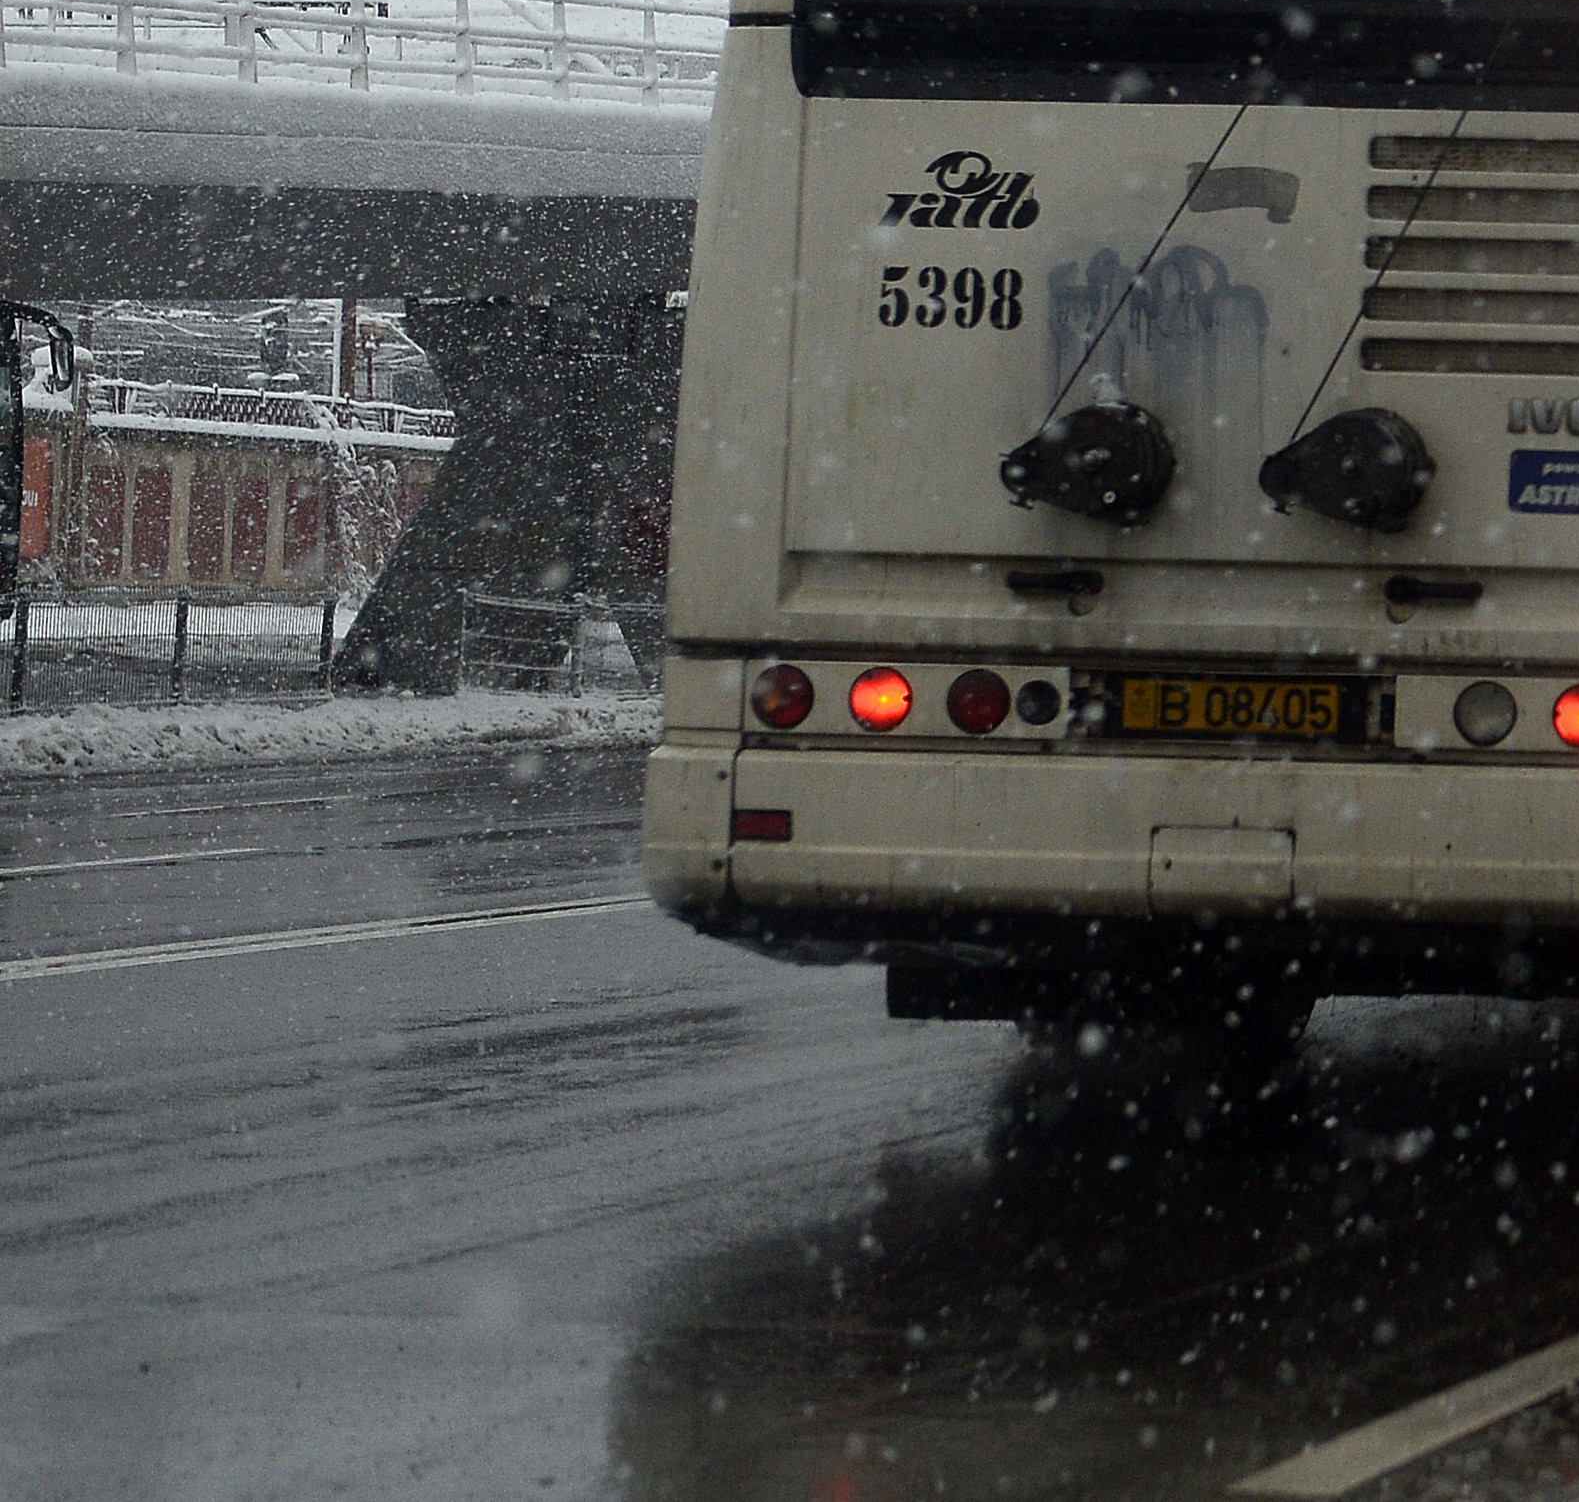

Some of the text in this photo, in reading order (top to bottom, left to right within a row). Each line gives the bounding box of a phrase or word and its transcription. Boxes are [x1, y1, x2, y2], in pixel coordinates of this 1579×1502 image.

[878, 265, 1024, 331] 5398
[1160, 684, 1332, 730] B 08405
